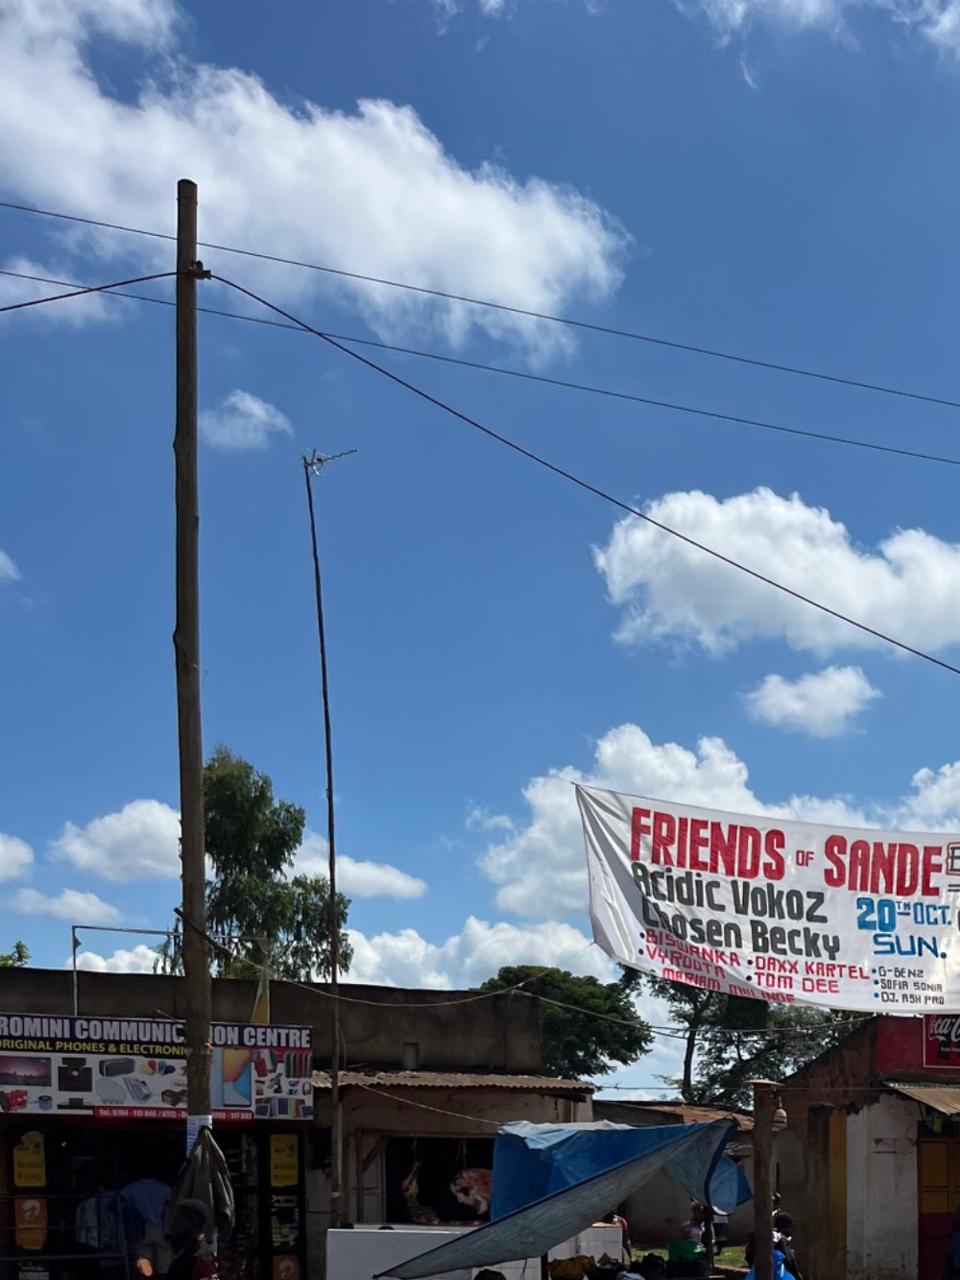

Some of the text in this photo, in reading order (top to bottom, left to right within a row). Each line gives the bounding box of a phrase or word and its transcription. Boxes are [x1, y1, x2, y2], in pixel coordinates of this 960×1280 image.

[631, 807, 785, 880] FRIENDS
[796, 850, 814, 867] OF
[824, 835, 943, 896] SANDE
[631, 862, 726, 912] Acidic
[913, 902, 952, 926] OCT.
[751, 920, 840, 961] Becky
[873, 934, 947, 959] SUN.
[755, 956, 870, 980] DAXX KARTEL
[754, 972, 840, 994] TOM DEE
[0, 1039, 52, 1051] RIGINAL
[56, 1041, 106, 1053] PHONES
[107, 1043, 117, 1053] &
[243, 1026, 312, 1048] CENTRE
